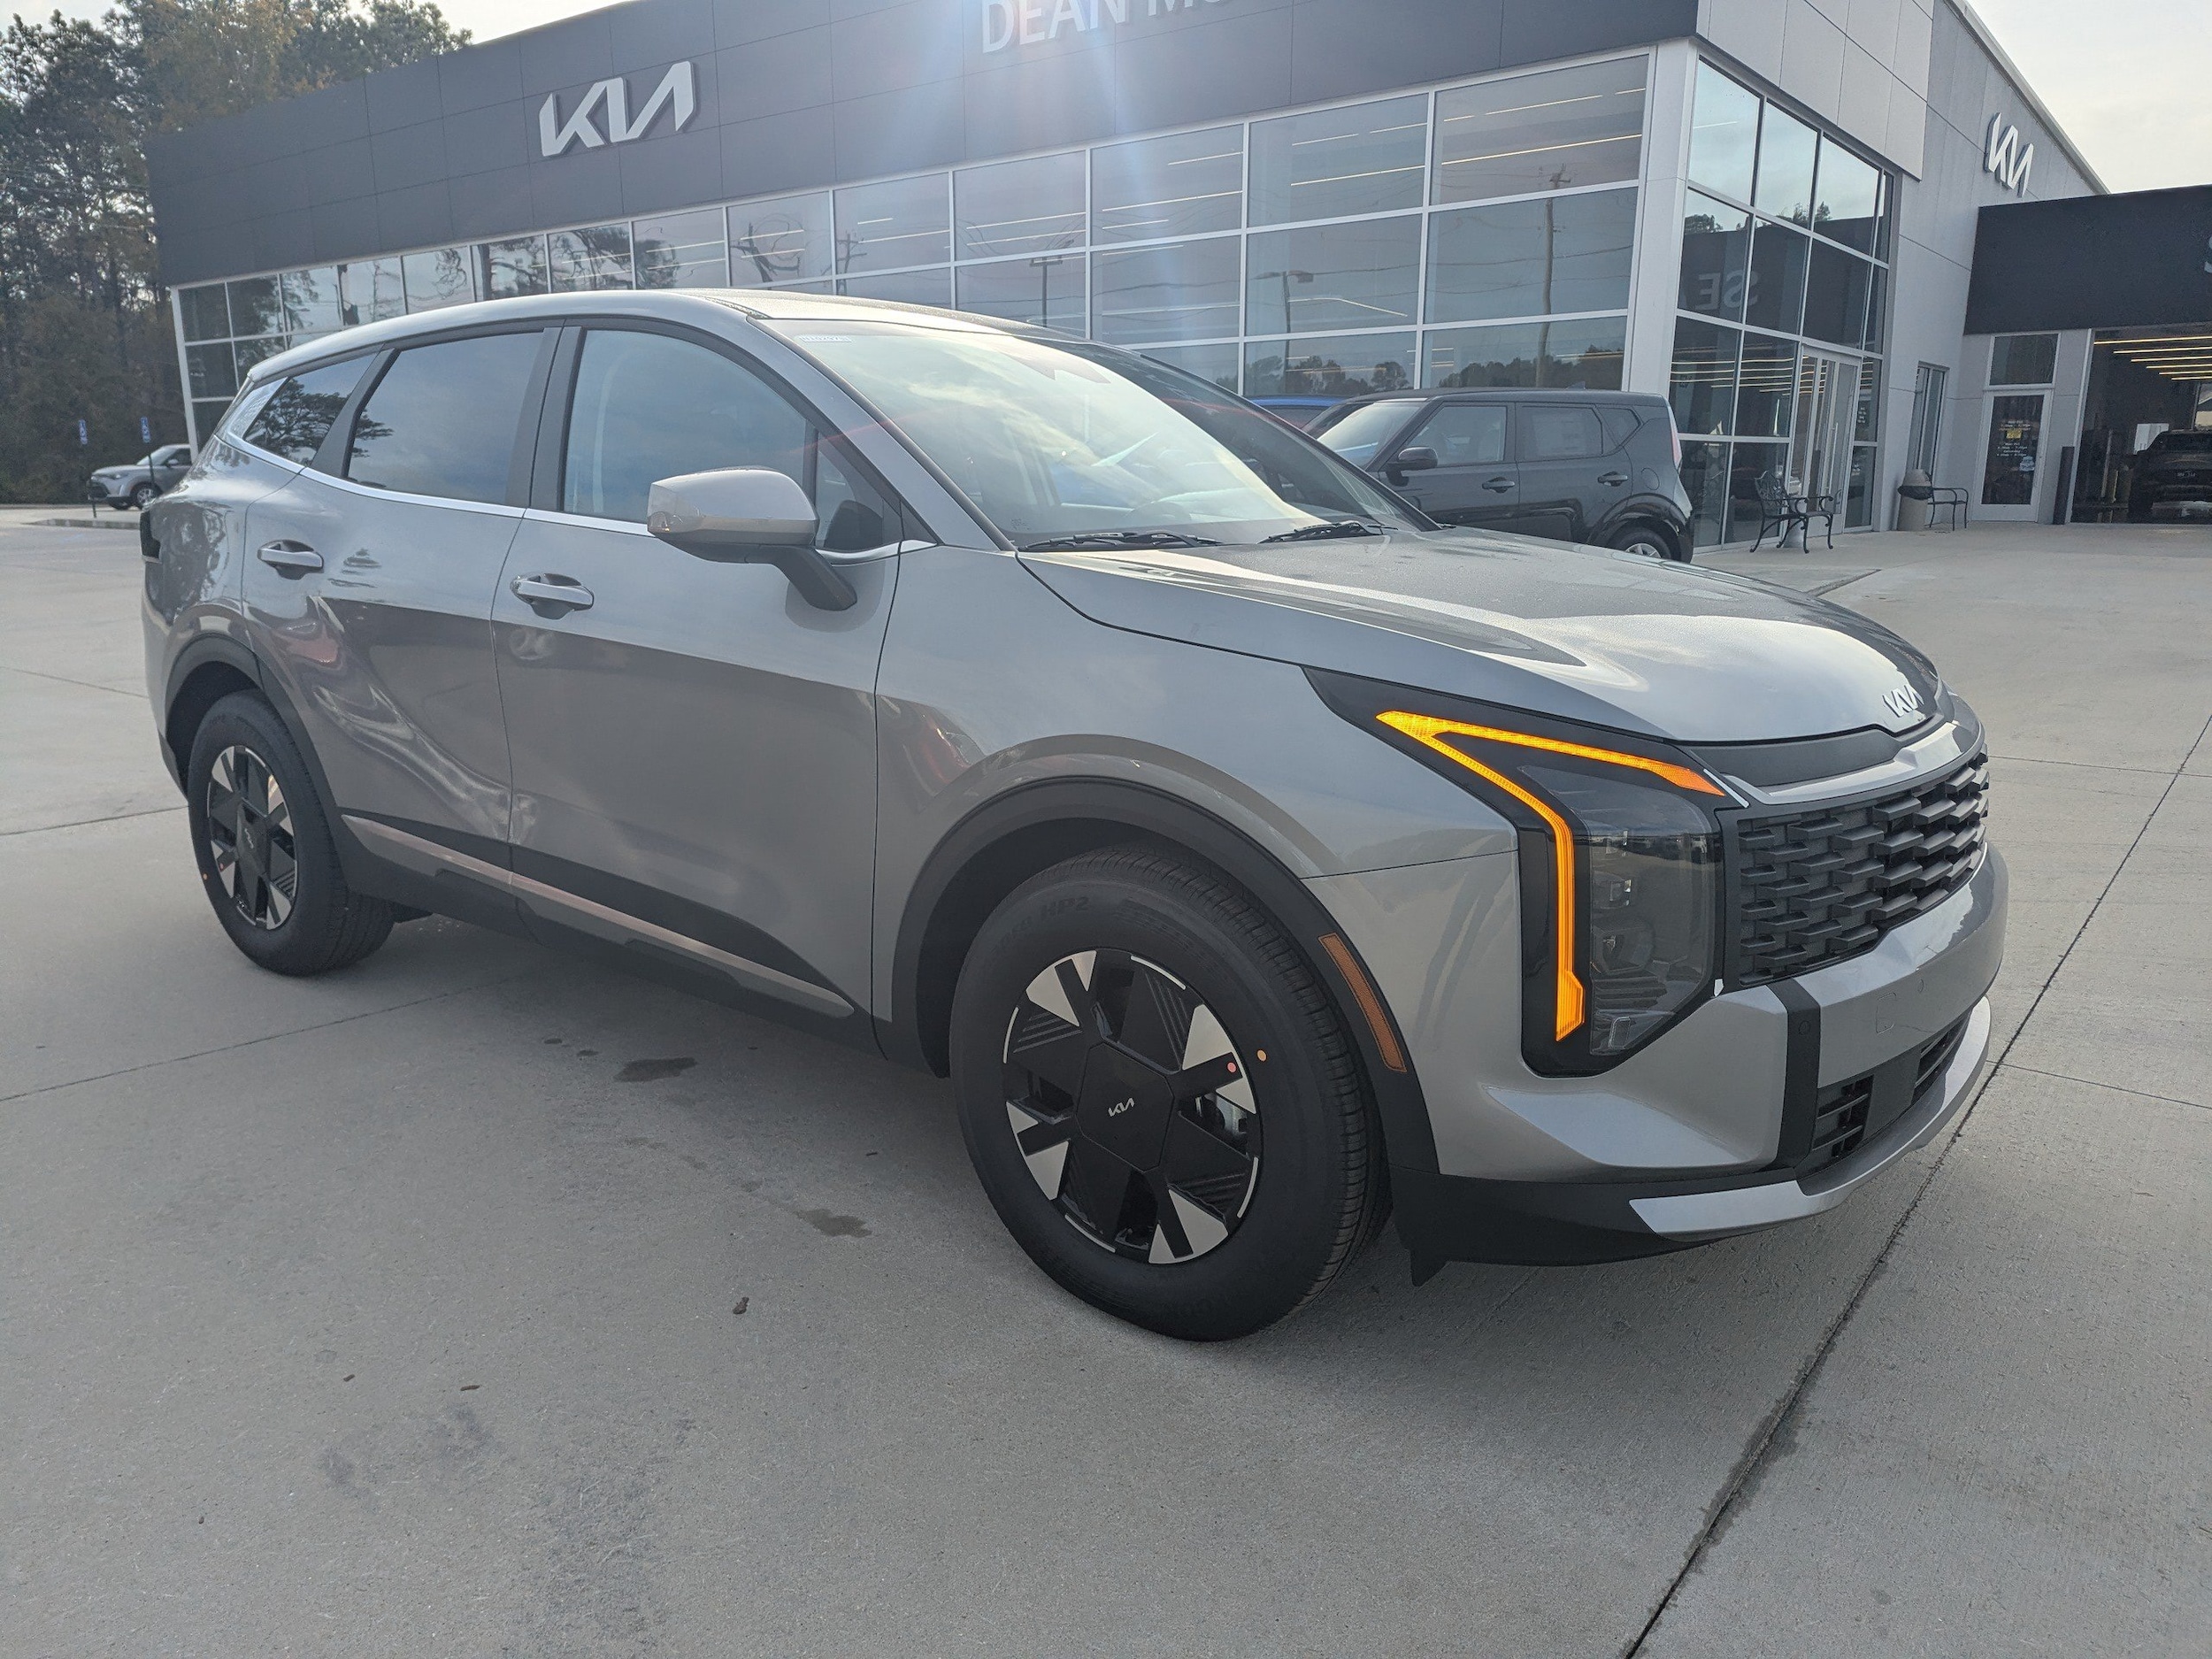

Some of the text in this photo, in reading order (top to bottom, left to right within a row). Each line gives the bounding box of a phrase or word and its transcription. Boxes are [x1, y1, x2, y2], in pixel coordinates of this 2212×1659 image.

[539, 60, 695, 157] KIA
[1985, 111, 2034, 196] KIA
[1882, 685, 1924, 718] KIA
[1108, 1097, 1135, 1117] KIA
